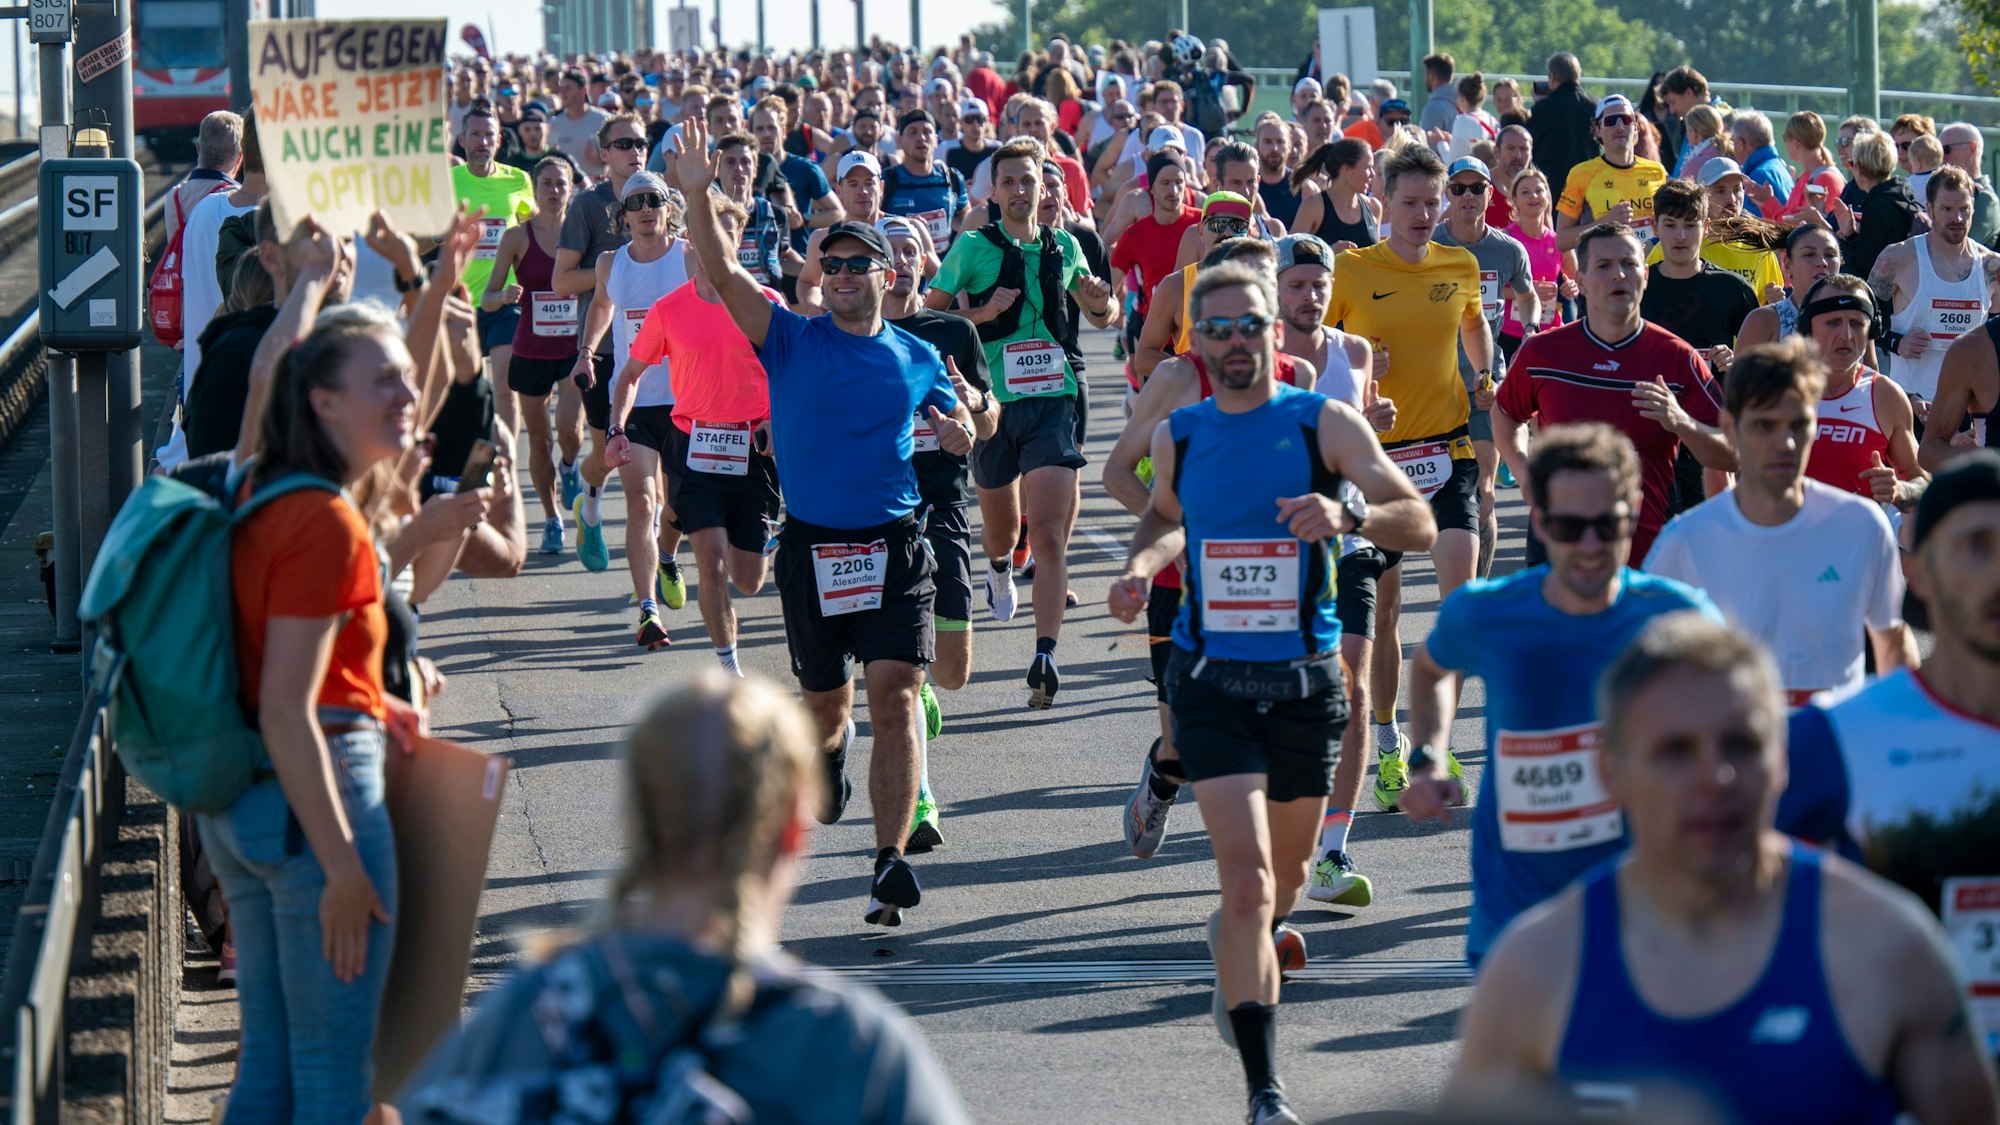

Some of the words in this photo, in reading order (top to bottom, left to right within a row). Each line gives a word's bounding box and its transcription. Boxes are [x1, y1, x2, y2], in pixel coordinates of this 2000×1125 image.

[34, 13, 65, 28] 807
[258, 25, 446, 80] AUFGEBEN
[253, 80, 339, 124] WÄRE
[355, 69, 443, 113] JETZT
[282, 125, 363, 163] AUCH
[67, 188, 114, 218] SF
[542, 303, 570, 313] 4019
[1940, 313, 1971, 323] 2608
[1016, 353, 1051, 366] 4039
[1022, 367, 1047, 375] Jasper
[696, 432, 746, 445] STAFFEL
[710, 444, 727, 452] T636
[1400, 461, 1436, 477] 003
[832, 558, 874, 576] 2206
[1220, 565, 1277, 582] 4373
[832, 574, 877, 587] Alexander
[1226, 586, 1272, 596] Sascha
[1512, 761, 1583, 789] 4689
